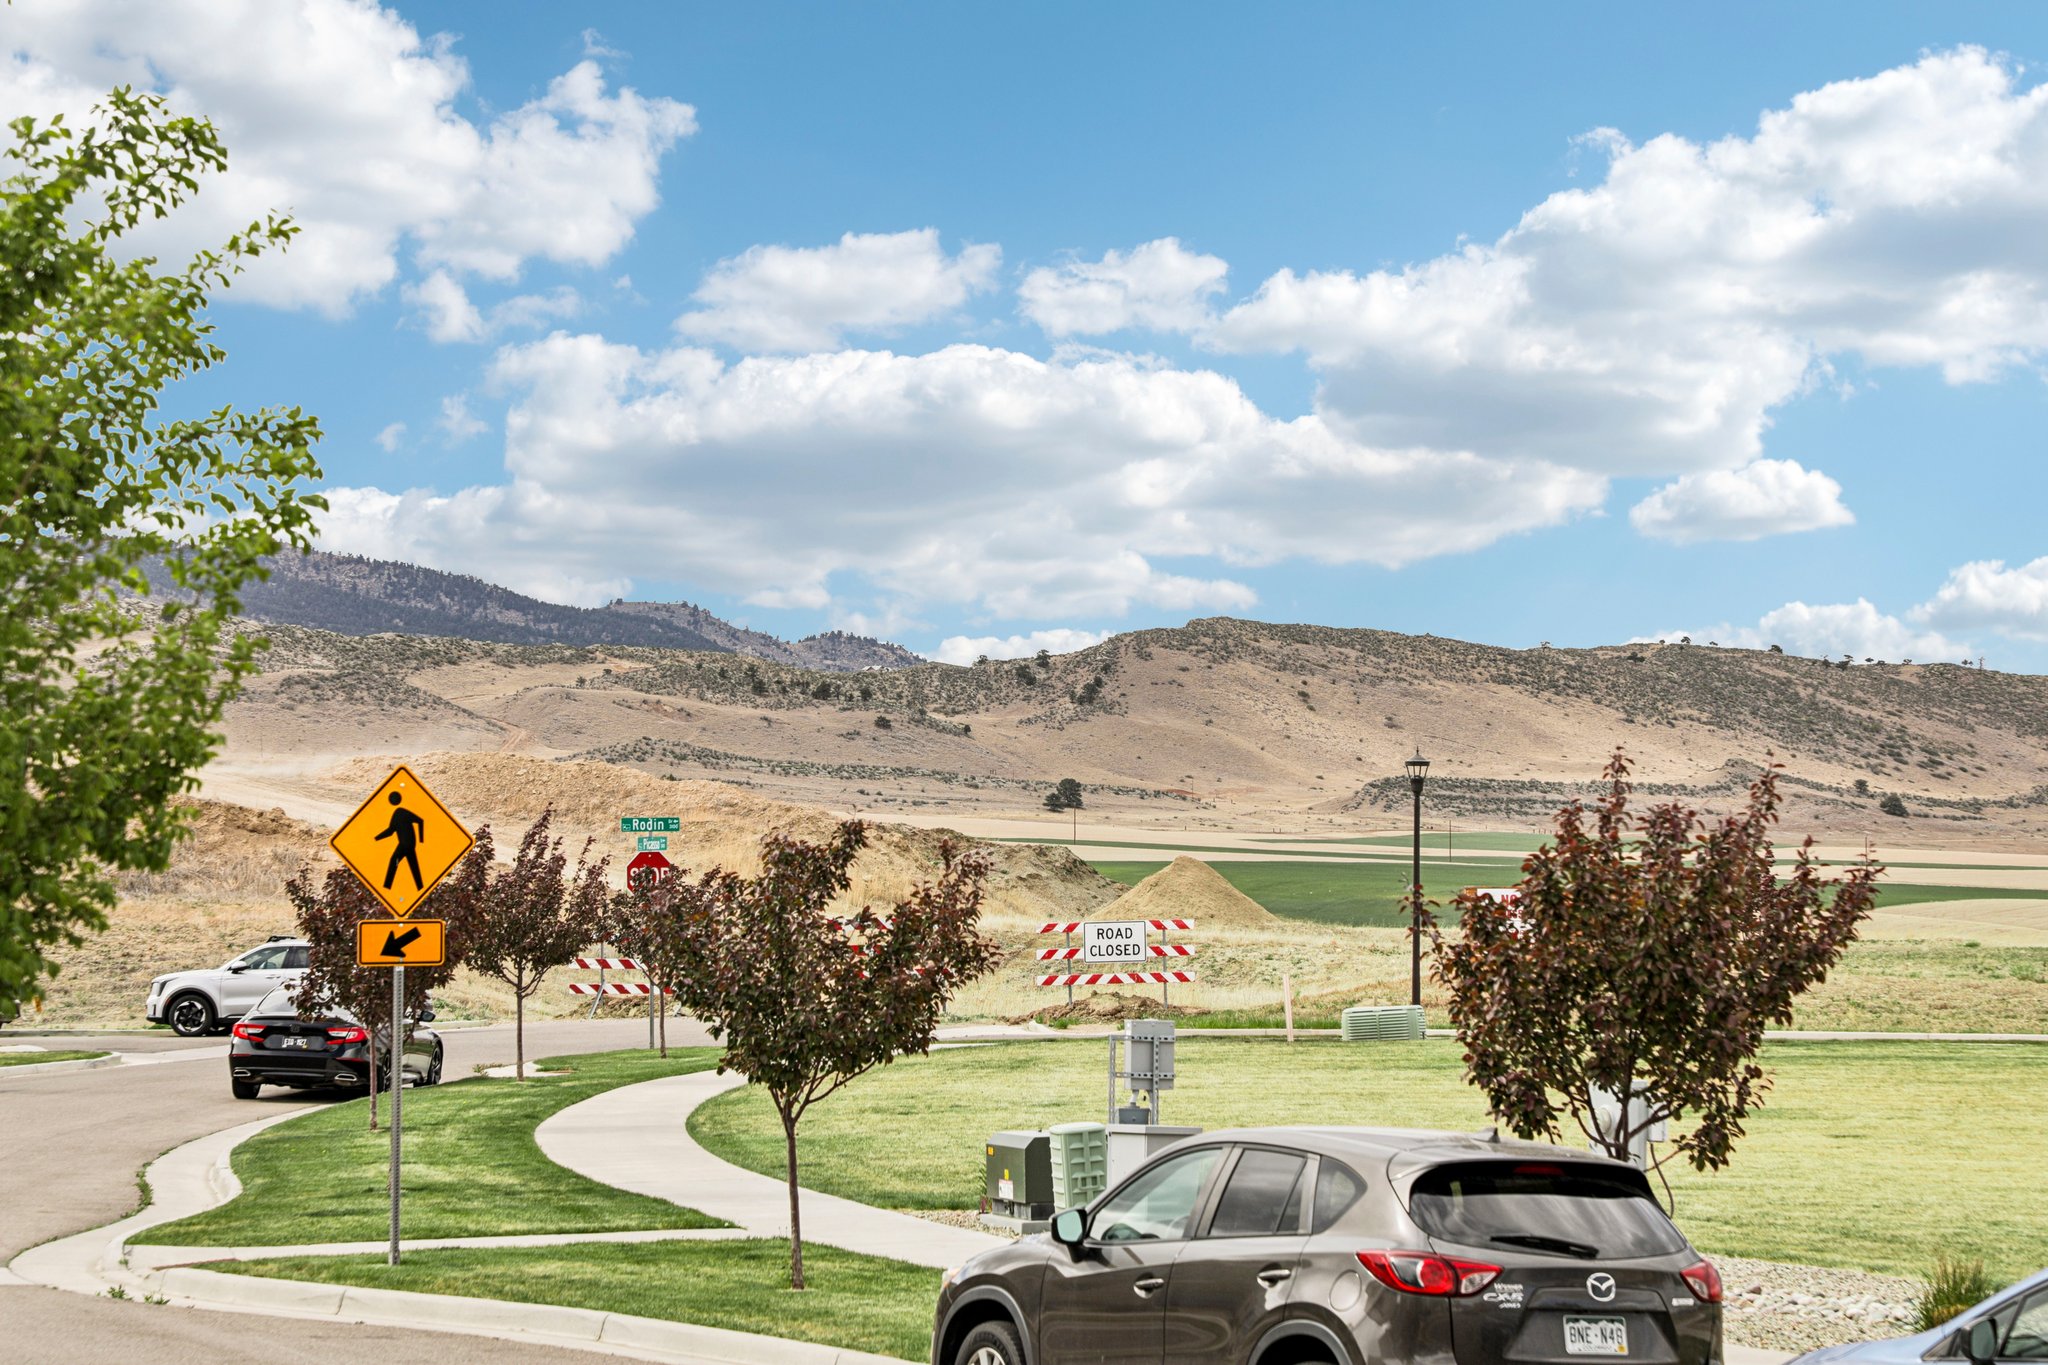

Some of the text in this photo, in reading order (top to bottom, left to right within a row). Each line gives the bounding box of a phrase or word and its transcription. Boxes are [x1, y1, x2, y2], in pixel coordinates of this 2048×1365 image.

[632, 818, 664, 831] Rodin
[1096, 927, 1133, 940] ROAD
[1089, 944, 1141, 957] CLOSED
